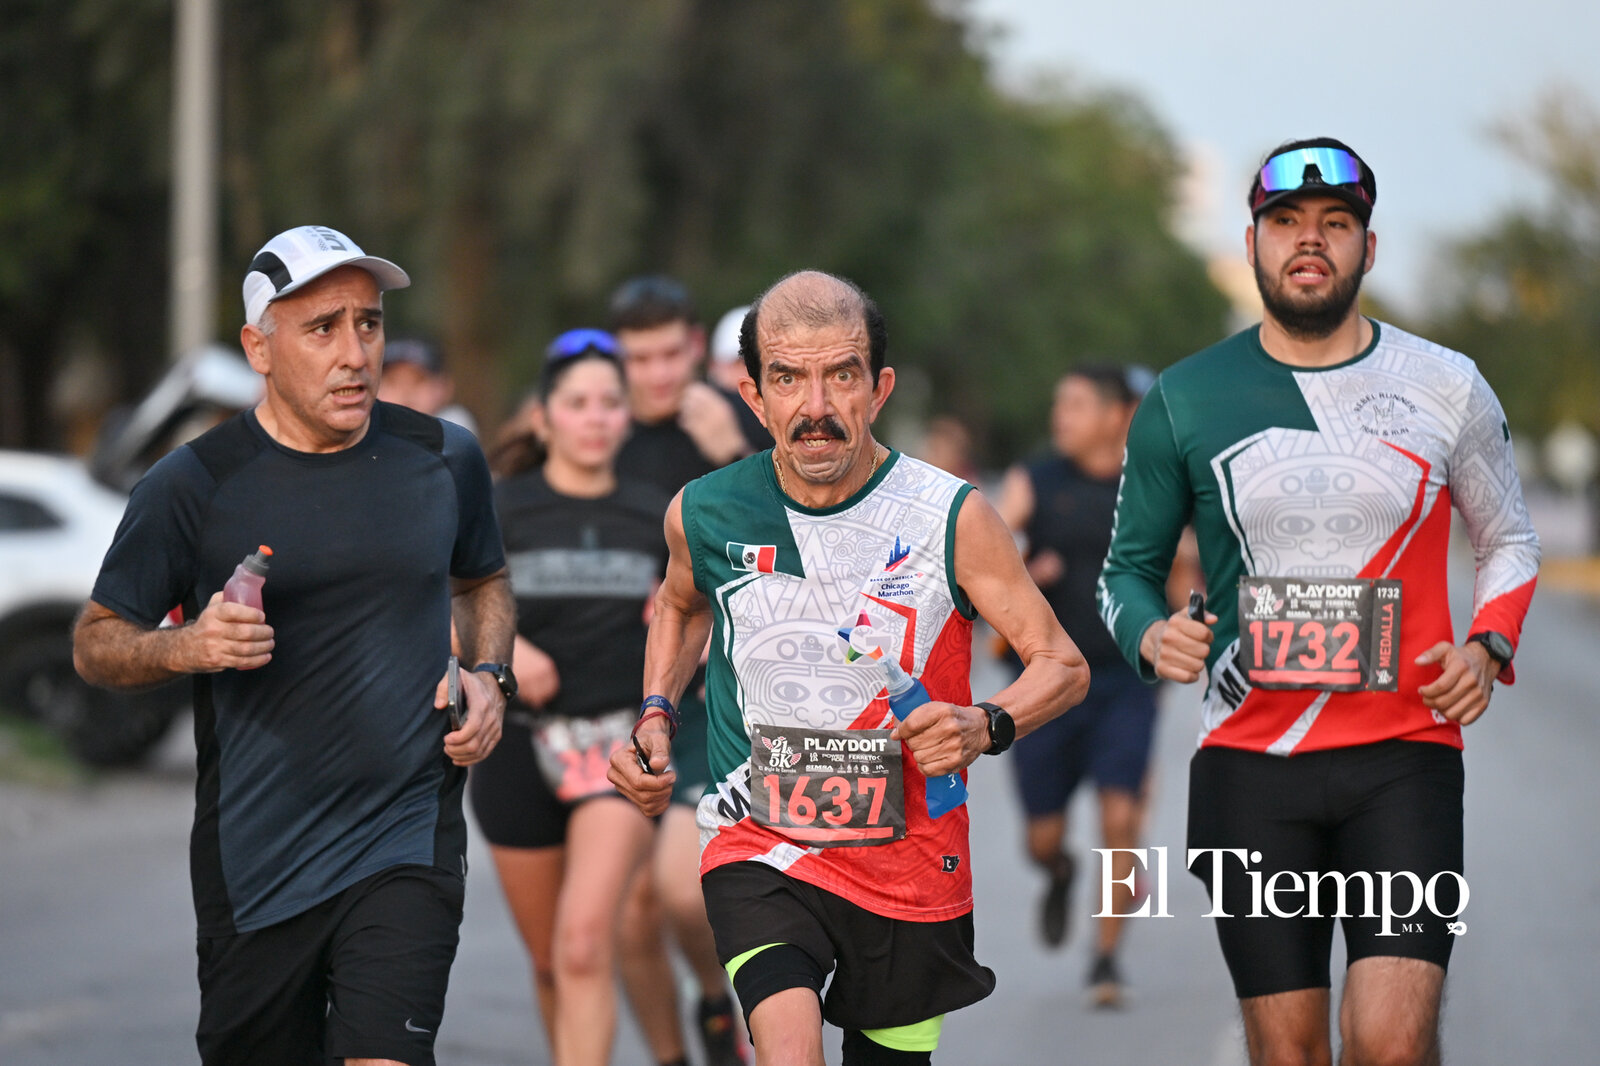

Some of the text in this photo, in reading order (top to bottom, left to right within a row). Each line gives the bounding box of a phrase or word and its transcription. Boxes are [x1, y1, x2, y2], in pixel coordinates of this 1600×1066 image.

[881, 582, 910, 590] Chicago
[1286, 583, 1362, 599] PLAYDOIT
[1377, 587, 1400, 599] 1732
[1379, 603, 1394, 668] MEDALLA
[1249, 620, 1360, 670] 1732
[772, 737, 787, 754] 21
[804, 737, 888, 752] PLAYDOIT
[769, 753, 792, 768] 5K
[763, 774, 888, 826] 1637
